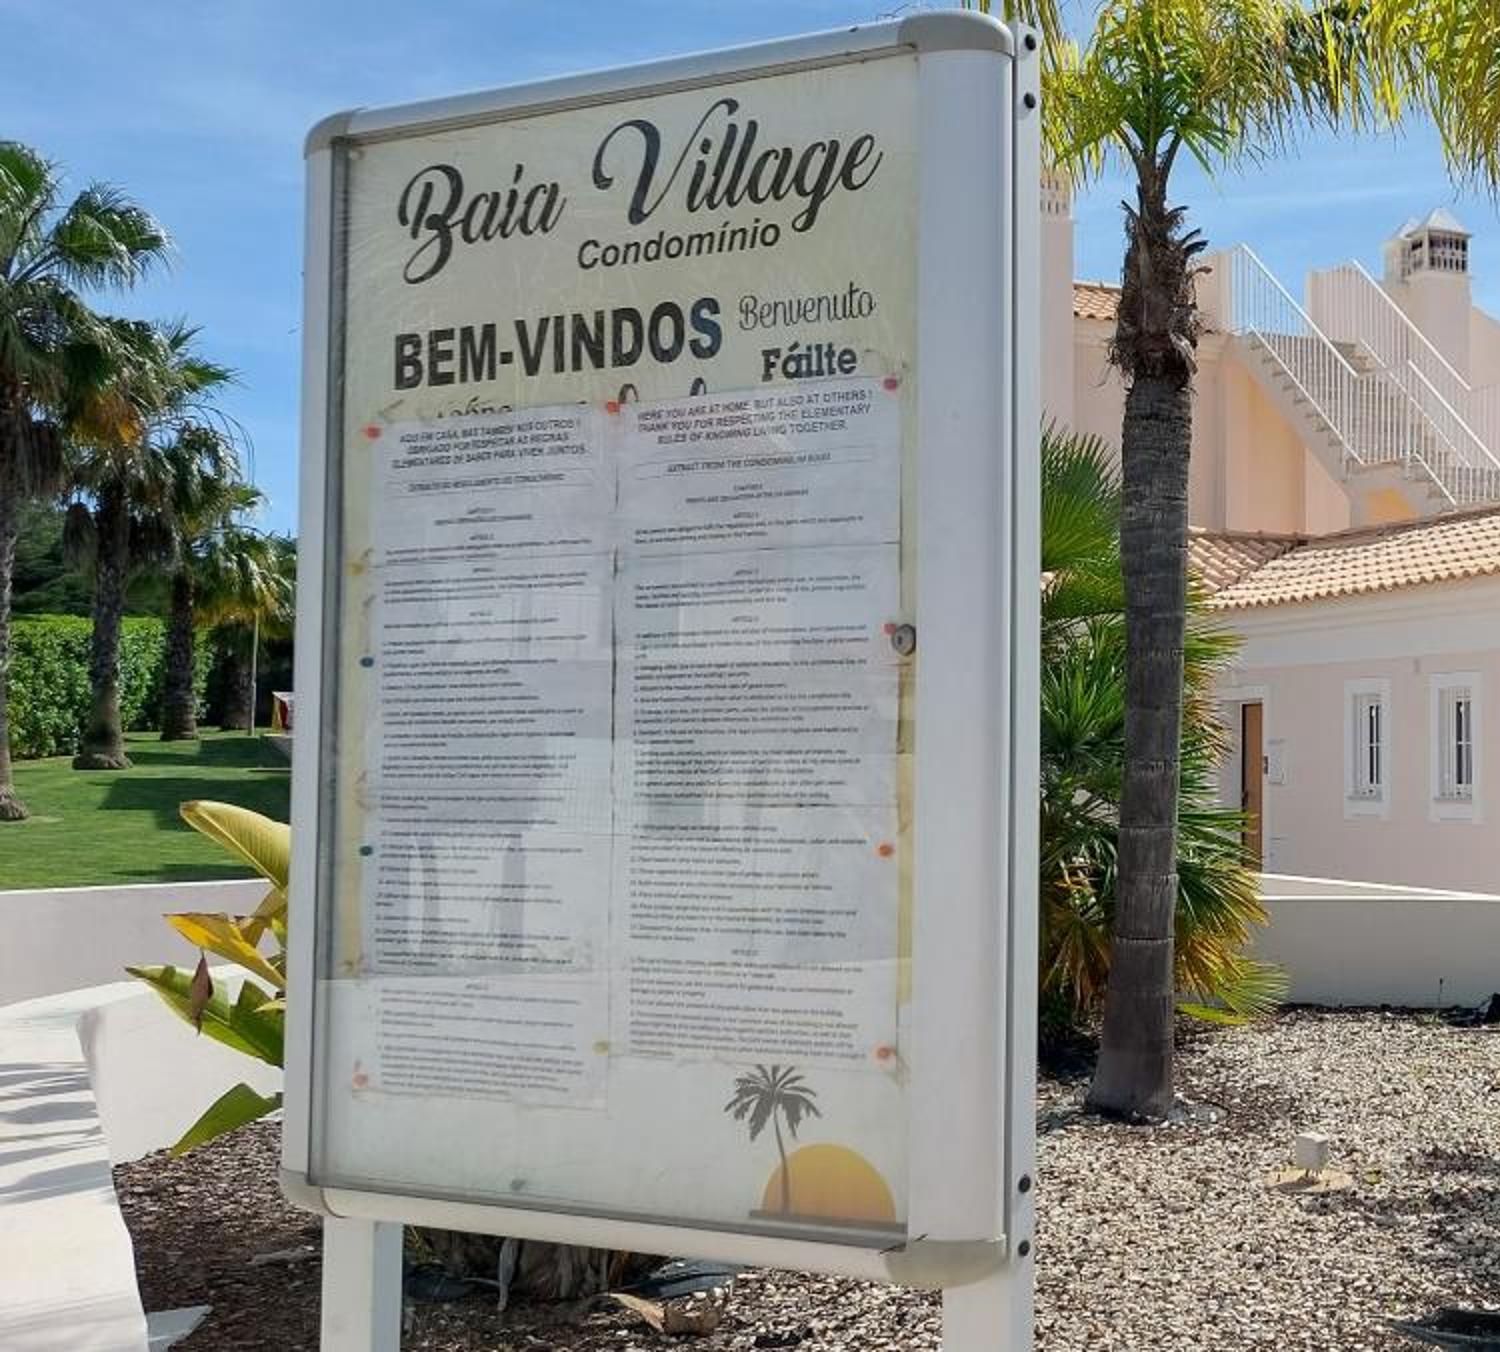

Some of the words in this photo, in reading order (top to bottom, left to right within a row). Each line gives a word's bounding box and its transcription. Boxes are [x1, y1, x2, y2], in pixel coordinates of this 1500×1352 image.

[592, 97, 883, 233] Village
[577, 218, 781, 270] Condomínio
[394, 296, 723, 391] BEM-VINDOS
[738, 280, 877, 331] Benvenuto
[761, 341, 858, 382] Fáilte
[666, 407, 688, 419] YOU
[688, 405, 707, 417] ARE
[709, 403, 721, 414] AT
[754, 398, 775, 409] BUT
[806, 393, 820, 404] AT
[823, 389, 867, 403] OTHERS
[671, 419, 692, 431] YOU
[801, 402, 871, 419] ELEMENTARY
